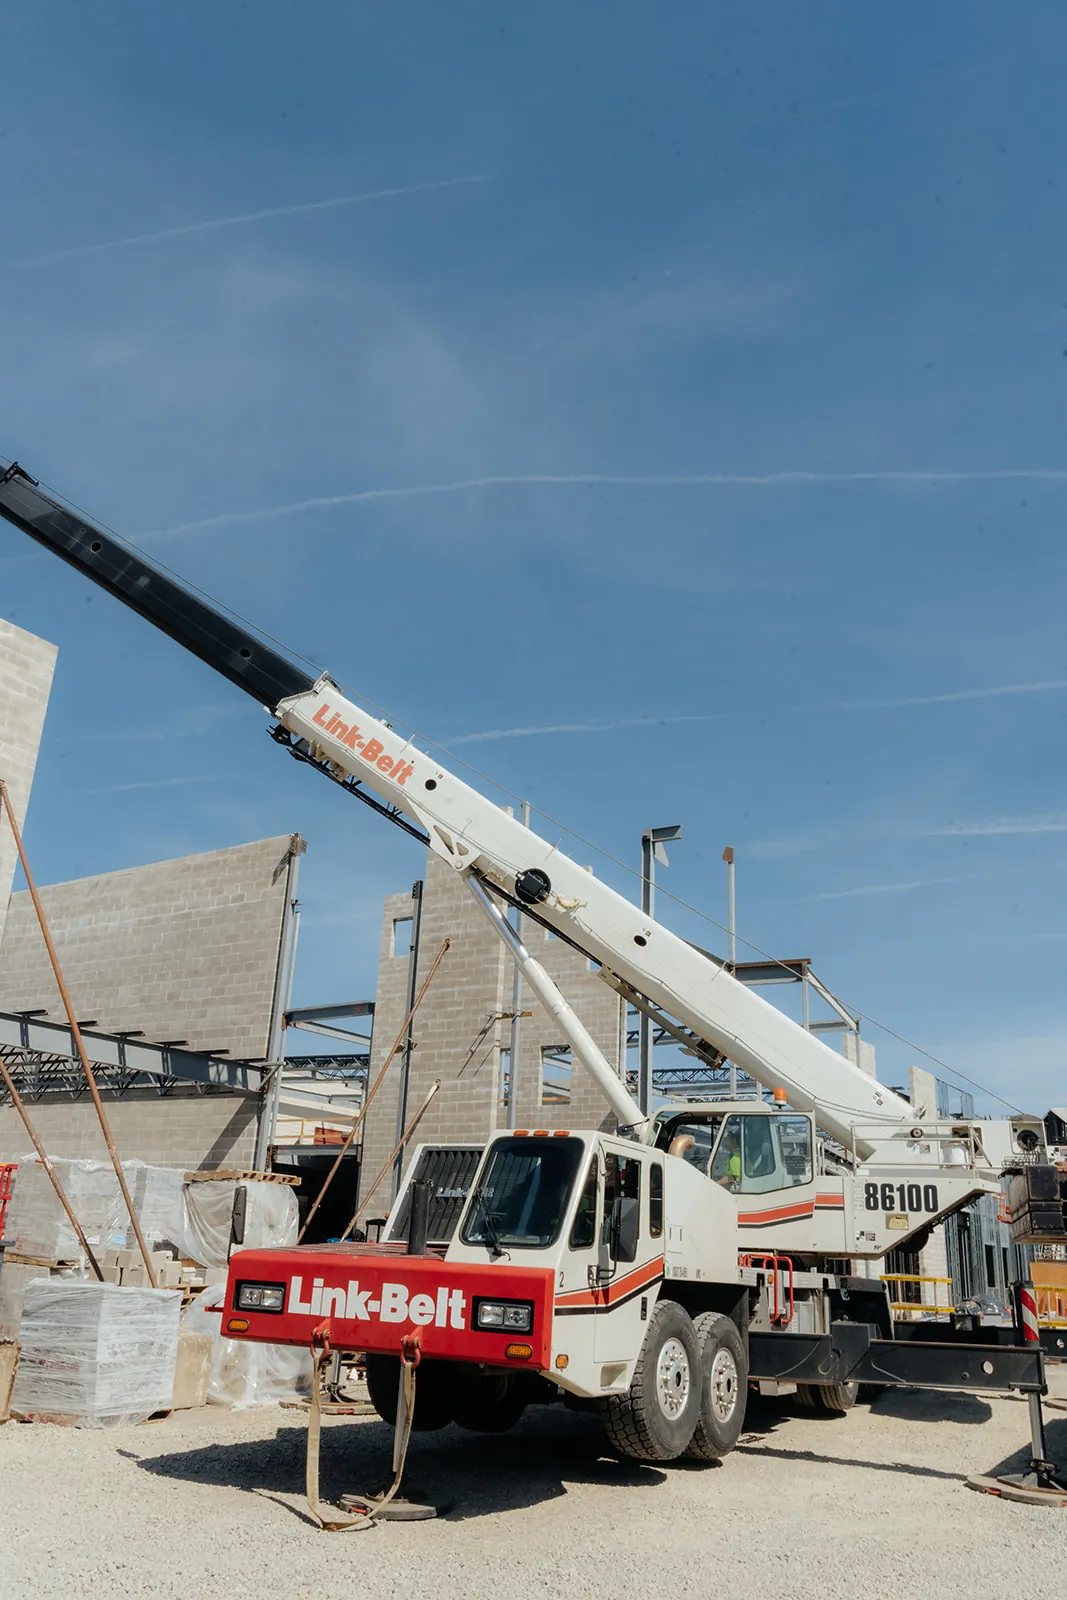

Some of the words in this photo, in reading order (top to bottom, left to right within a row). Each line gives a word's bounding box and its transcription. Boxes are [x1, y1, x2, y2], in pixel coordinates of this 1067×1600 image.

[312, 703, 414, 786] Link-Belt
[864, 1183, 938, 1213] 86100
[559, 1271, 564, 1287] 2
[288, 1276, 466, 1330] Link-Belt
